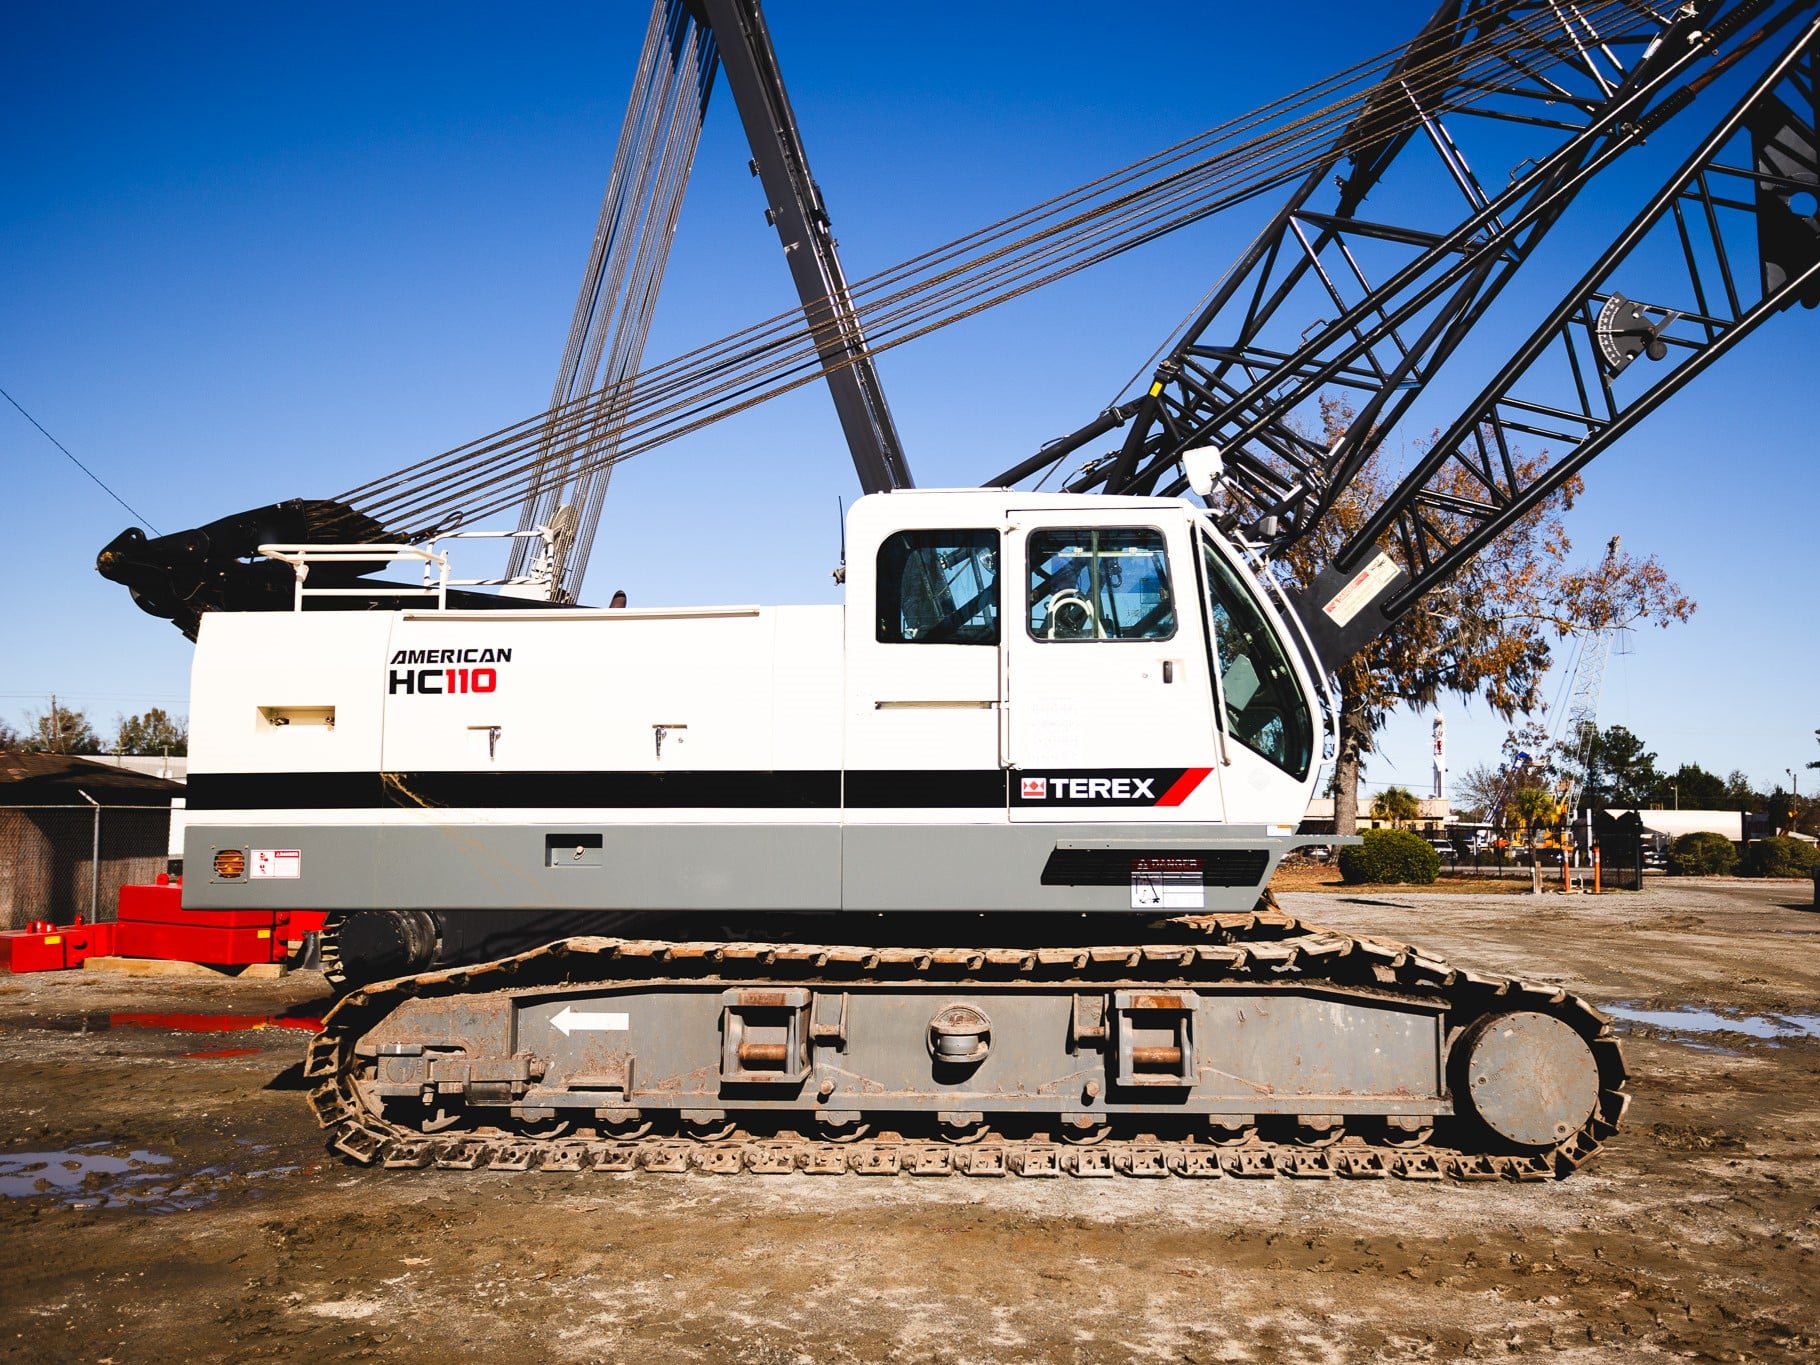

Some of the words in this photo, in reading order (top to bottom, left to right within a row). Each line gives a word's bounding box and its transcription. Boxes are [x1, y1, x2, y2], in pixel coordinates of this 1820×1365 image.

[390, 648, 512, 664] AMERICAN
[389, 668, 496, 694] HC110
[1049, 778, 1155, 799] TEREX
